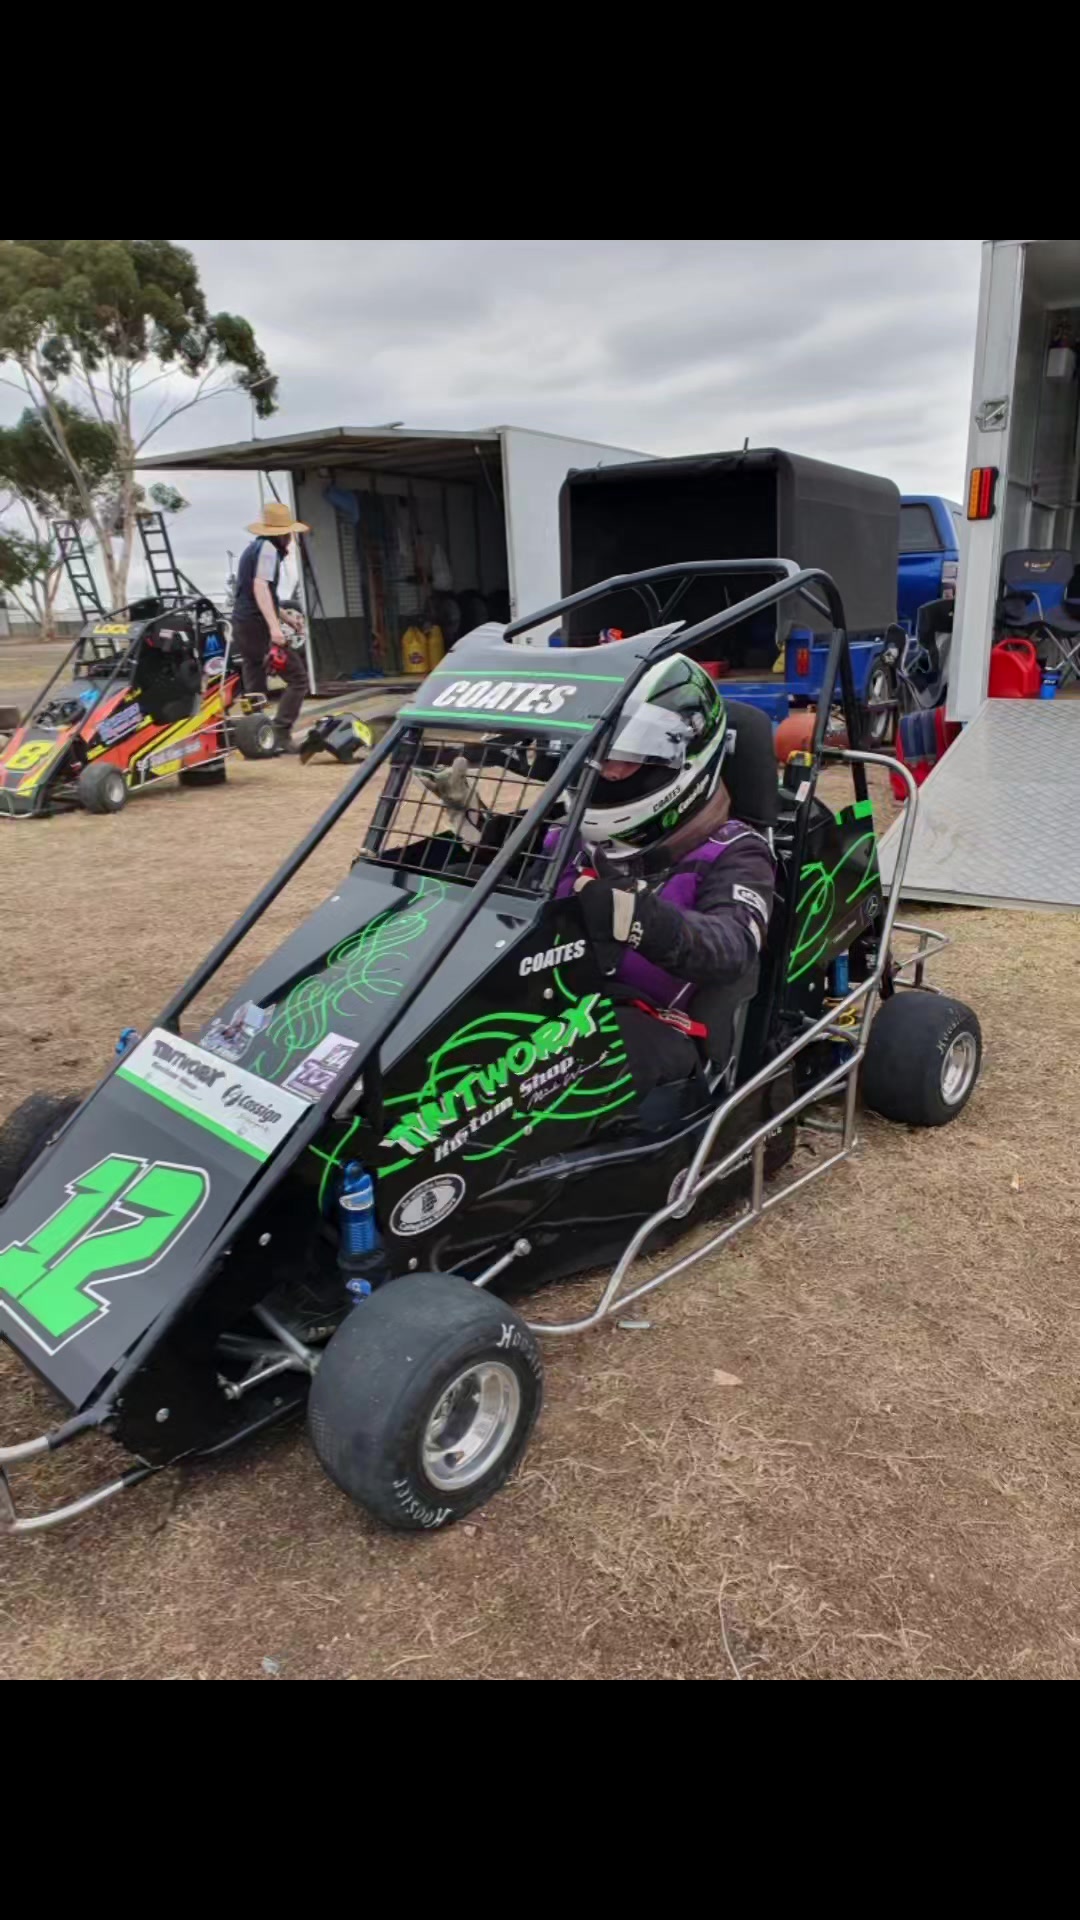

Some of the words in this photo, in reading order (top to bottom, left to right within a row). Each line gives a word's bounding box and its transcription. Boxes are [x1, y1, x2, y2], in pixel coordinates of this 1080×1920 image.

[432, 681, 577, 714] COATES
[4, 741, 54, 770] 8
[653, 785, 681, 812] COATES
[518, 939, 586, 976] COATES
[378, 992, 602, 1155] TINTWORX
[519, 1056, 574, 1098] Shop
[0, 1153, 210, 1356] 12
[392, 1479, 454, 1528] Hoosier
